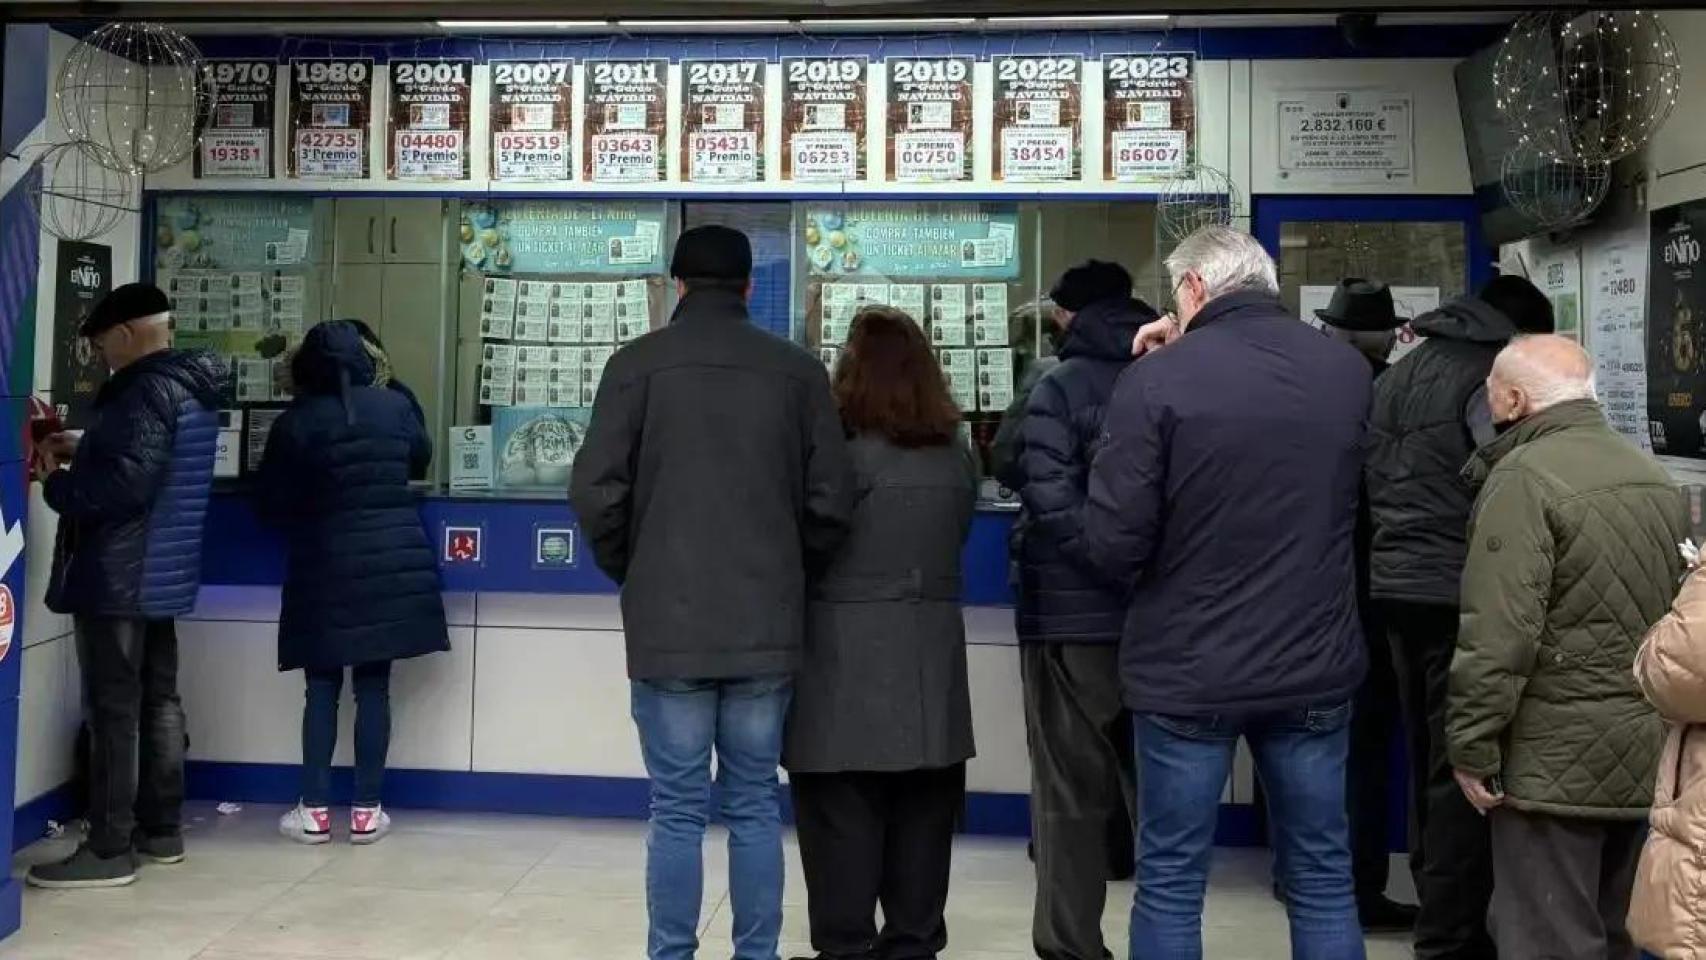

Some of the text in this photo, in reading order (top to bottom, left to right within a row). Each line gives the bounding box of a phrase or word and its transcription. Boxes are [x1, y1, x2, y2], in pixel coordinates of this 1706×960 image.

[204, 62, 270, 84] 1970
[297, 62, 366, 84] 1980
[396, 63, 466, 84] 2001
[495, 63, 568, 84] 2007
[594, 63, 658, 84] 2011
[689, 63, 758, 84] 2017
[789, 61, 861, 82] 2019
[894, 61, 967, 82] 2019
[998, 58, 1076, 80] 2022
[1108, 57, 1188, 79] 2023
[420, 84, 457, 93] Gordo
[518, 84, 558, 93] Gordo
[614, 85, 652, 93] Gordo
[712, 85, 750, 93] Gordo
[1136, 80, 1177, 88] Gordo
[301, 94, 361, 102] NAVIDAD
[400, 94, 462, 102] NAVIDAD
[501, 94, 562, 102] NAVIDAD
[595, 94, 657, 102] NAVIDAD
[692, 94, 754, 102] NAVIDAD
[792, 92, 857, 101] NAVIDAD
[897, 92, 962, 101] NAVIDAD
[1004, 90, 1070, 99] NAVIDAD
[1114, 89, 1182, 99] NAVIDAD
[1301, 118, 1387, 132] 2.832.160 €
[301, 133, 357, 147] 42735
[401, 134, 457, 149] 04480
[500, 136, 560, 150] 05519
[599, 139, 652, 152] 03643
[695, 136, 750, 150] 05431
[209, 148, 260, 161] 19381
[313, 149, 357, 160] Premio
[413, 150, 458, 162] Premio
[513, 151, 562, 162] Premio
[610, 153, 653, 164] Premio
[709, 151, 751, 162] Premio
[1009, 147, 1066, 161] 38454
[1119, 148, 1179, 161] 86007
[865, 227, 955, 240] COMPRA TAMBIEN
[880, 244, 913, 256] TICKET
